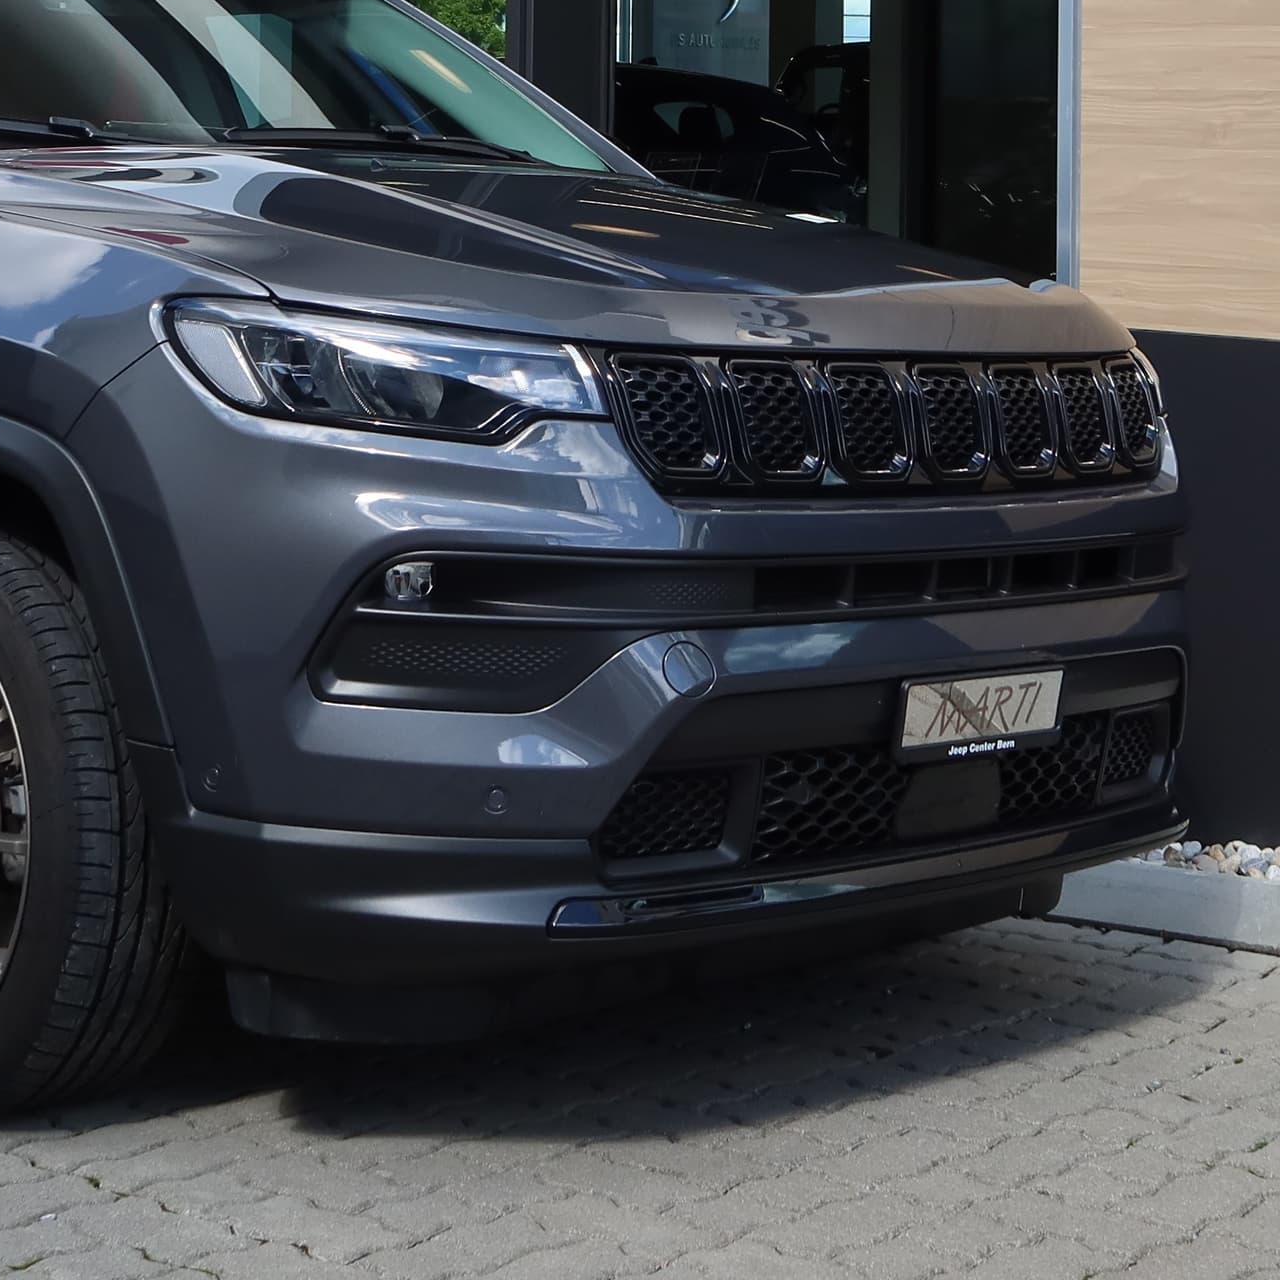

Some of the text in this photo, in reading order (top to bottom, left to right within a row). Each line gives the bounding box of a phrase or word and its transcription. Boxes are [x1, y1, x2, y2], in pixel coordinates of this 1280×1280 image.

[924, 679, 1042, 739] MARTI
[948, 739, 1015, 756] Jeep Center Bern
